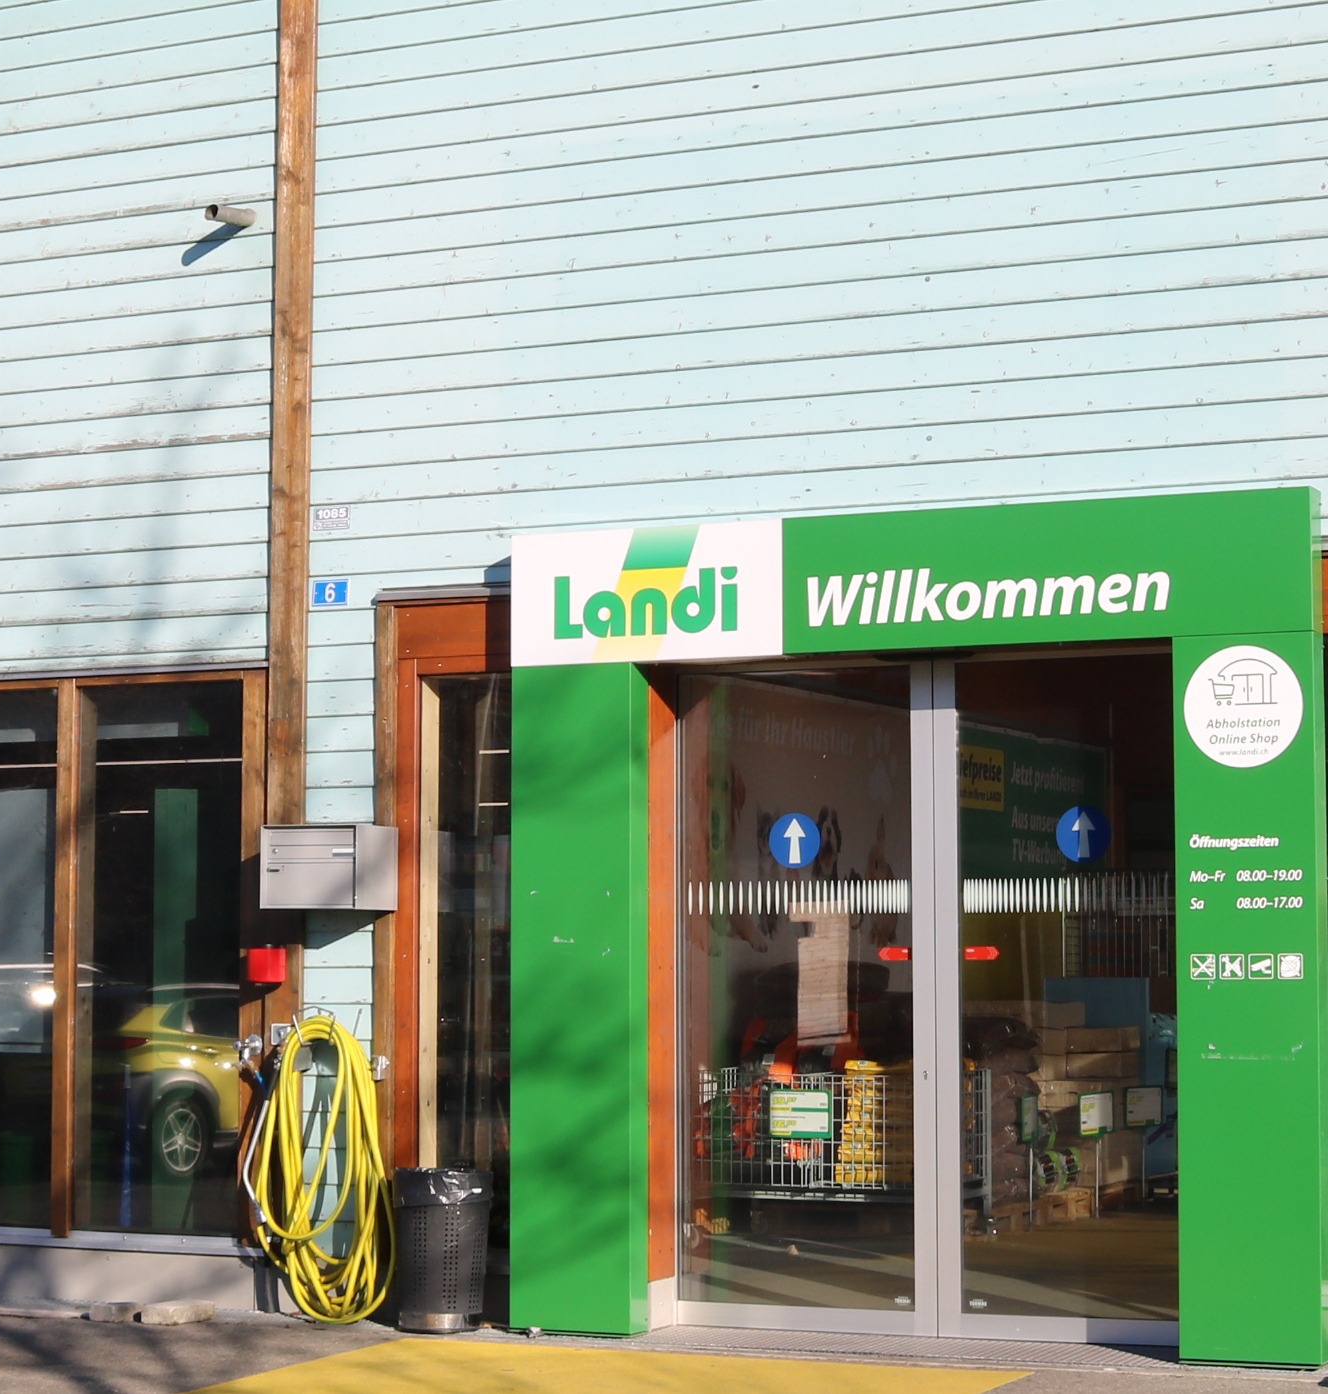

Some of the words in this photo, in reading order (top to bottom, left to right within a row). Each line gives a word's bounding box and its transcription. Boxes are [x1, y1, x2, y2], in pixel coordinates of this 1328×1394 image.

[317, 508, 347, 519] 1085
[324, 583, 336, 603] 6
[806, 568, 1171, 627] Willkommen
[554, 565, 738, 640] Landi
[1206, 717, 1281, 729] Abholstation
[1209, 734, 1247, 745] Online
[1249, 733, 1279, 745] Shop
[1219, 748, 1269, 756] www.landi.ch
[1011, 761, 1033, 786] Jetzt
[1011, 805, 1028, 830] Aus
[1189, 834, 1279, 850] Öffnungszeiten
[1190, 898, 1204, 909] Sa
